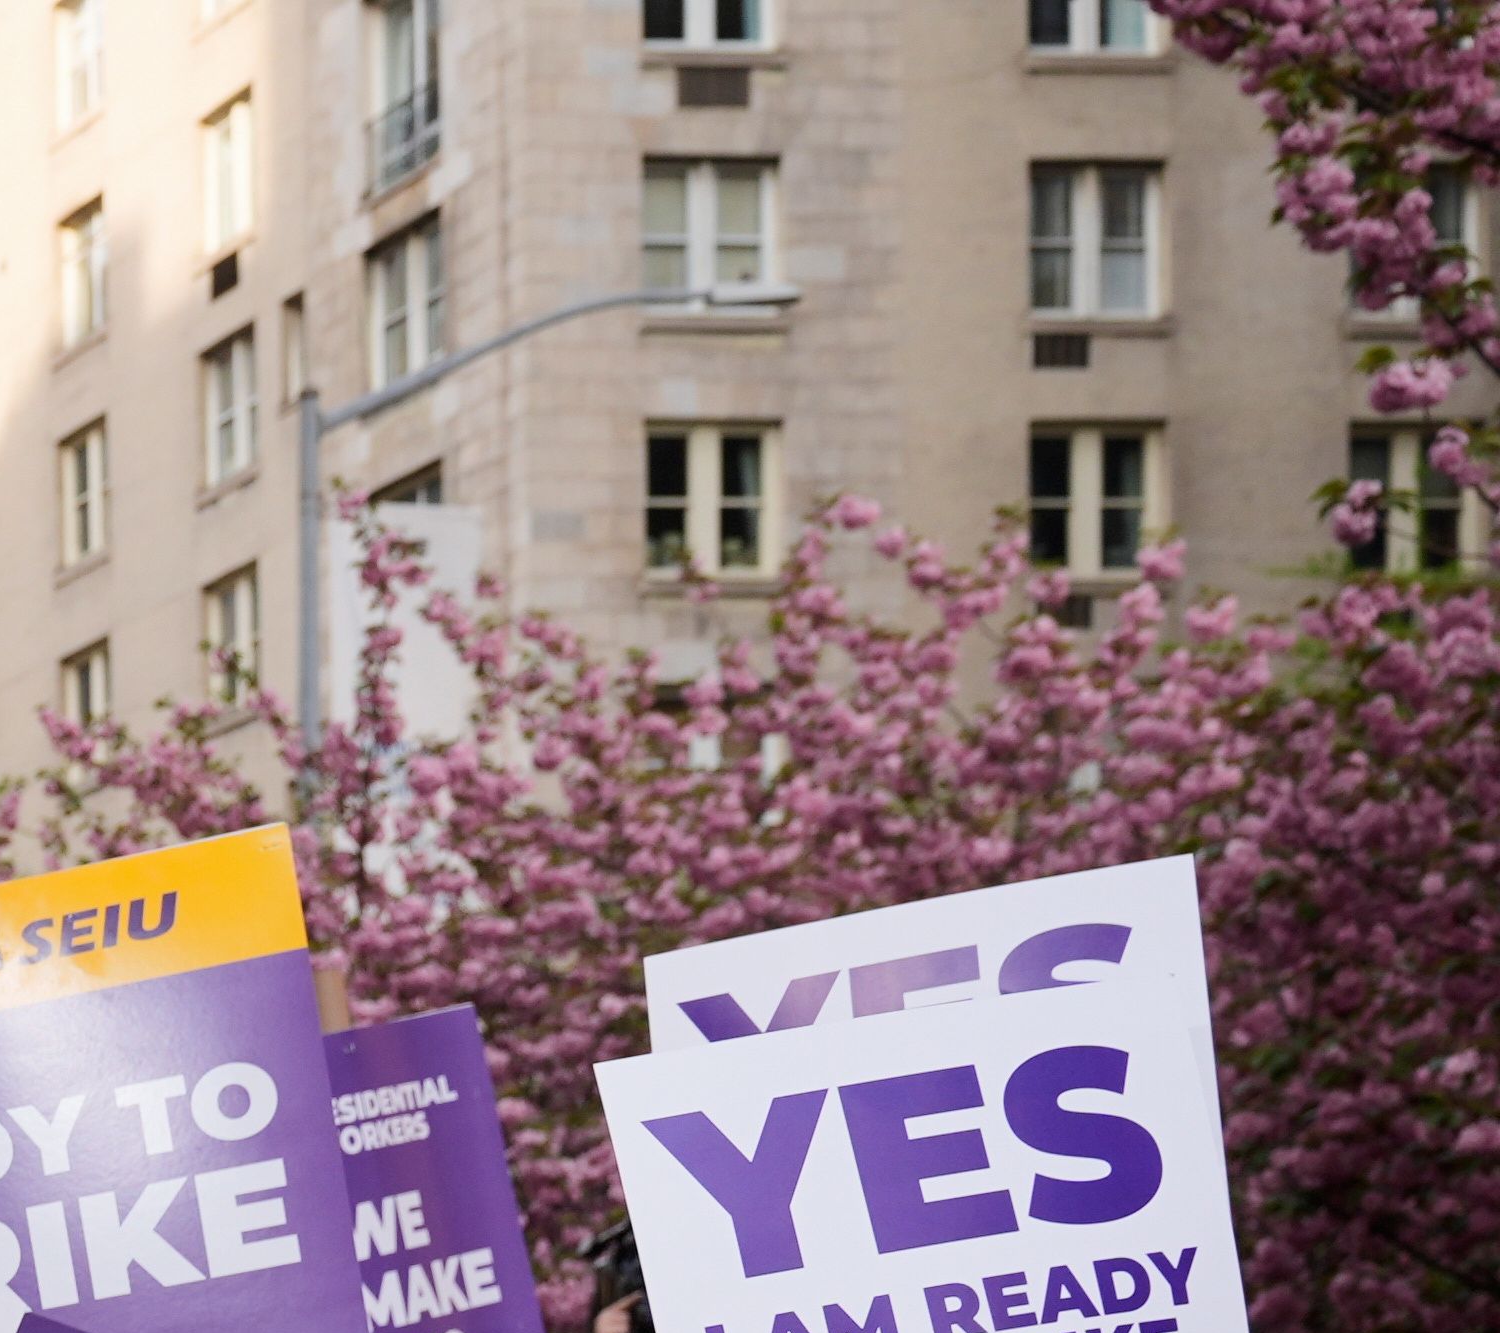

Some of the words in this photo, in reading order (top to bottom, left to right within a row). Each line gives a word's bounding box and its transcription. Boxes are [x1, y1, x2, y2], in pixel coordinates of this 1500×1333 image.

[18, 892, 179, 967] SEIU
[116, 1063, 278, 1156] TO
[641, 1045, 1164, 1279] YES
[362, 1247, 502, 1333] MAKE
